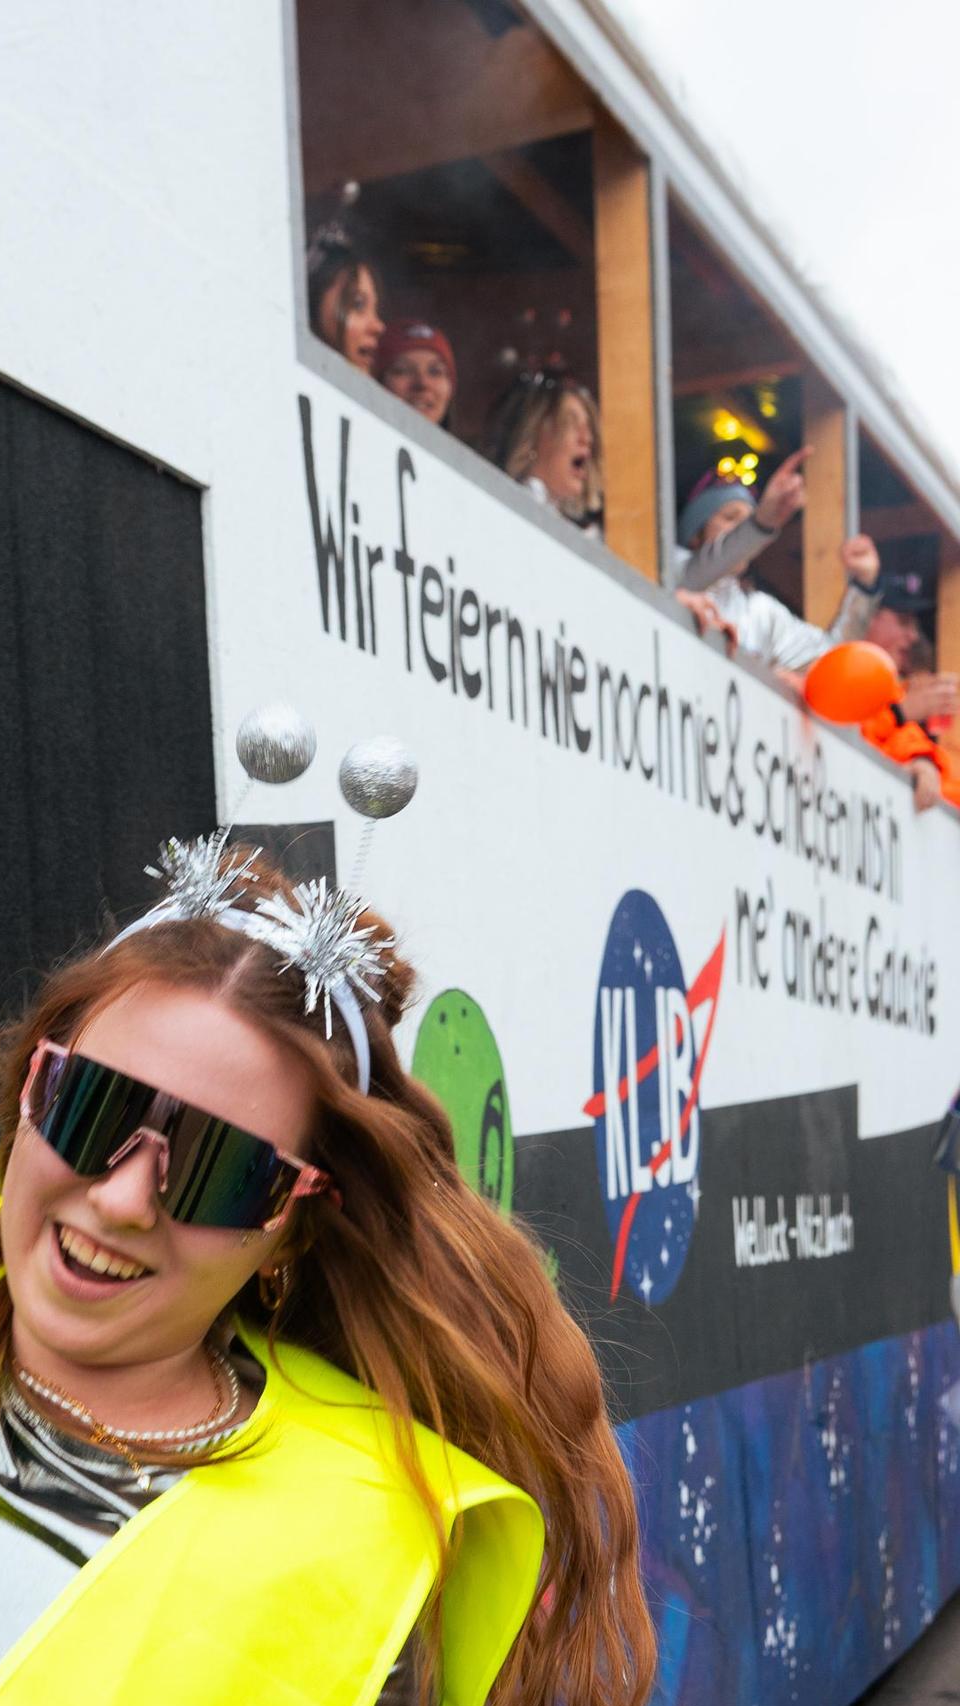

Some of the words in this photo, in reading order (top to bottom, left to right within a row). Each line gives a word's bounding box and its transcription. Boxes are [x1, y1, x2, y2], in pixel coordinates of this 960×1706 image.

[299, 394, 382, 656] Wir
[394, 448, 529, 729] feiern
[536, 622, 592, 753] wie
[597, 629, 674, 793] noch
[679, 696, 722, 814] nie
[725, 680, 745, 826] &
[887, 796, 903, 904] in
[782, 897, 860, 1014] andere
[864, 915, 937, 1037] Galaxie
[600, 986, 700, 1200] KLJB
